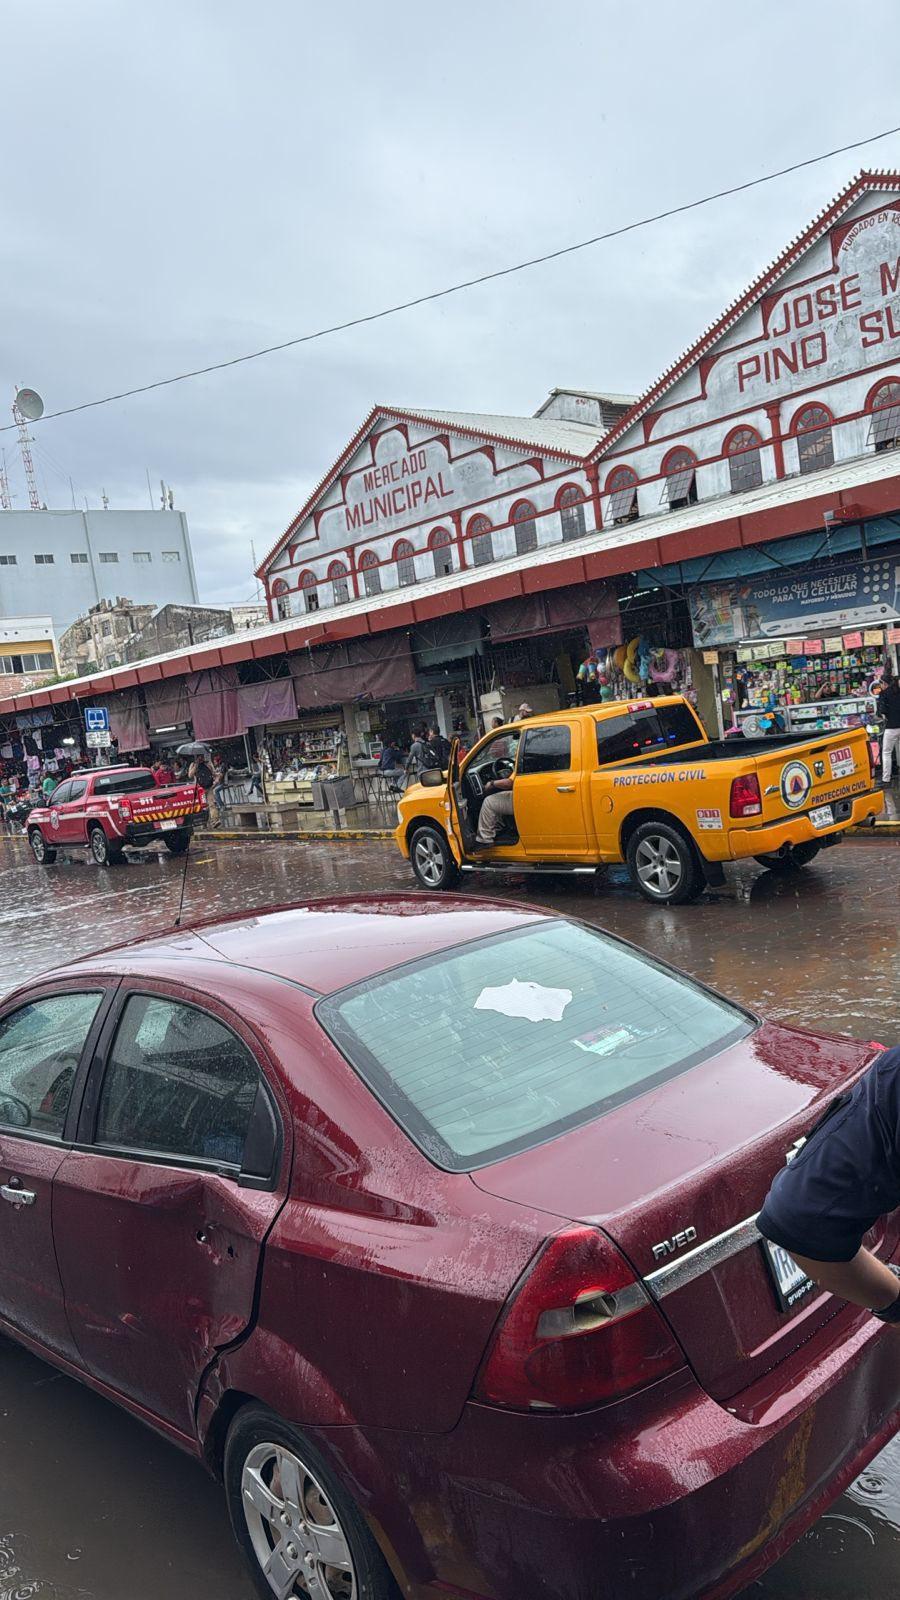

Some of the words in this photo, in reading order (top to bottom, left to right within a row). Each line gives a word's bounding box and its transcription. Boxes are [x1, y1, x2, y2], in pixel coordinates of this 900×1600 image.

[842, 217, 875, 252] FUNDADO
[878, 212, 889, 224] EN
[773, 273, 862, 338] JOSE
[737, 331, 828, 393] PINO
[363, 449, 427, 493] MERCADO
[344, 472, 454, 531] MUNICIPAL
[753, 589, 776, 599] TODO
[778, 586, 789, 594] LO
[791, 582, 808, 593] QUE
[811, 573, 857, 588] NECESITES
[772, 594, 794, 604] PARA
[796, 589, 809, 599] TU
[811, 581, 858, 597] CELULAR
[829, 748, 851, 763] 911
[679, 769, 707, 782] CIVIL
[852, 781, 866, 792] CIVIL
[697, 809, 720, 818] 911
[652, 1226, 697, 1260] AVEO
[788, 1280, 816, 1306] grupo-pr
